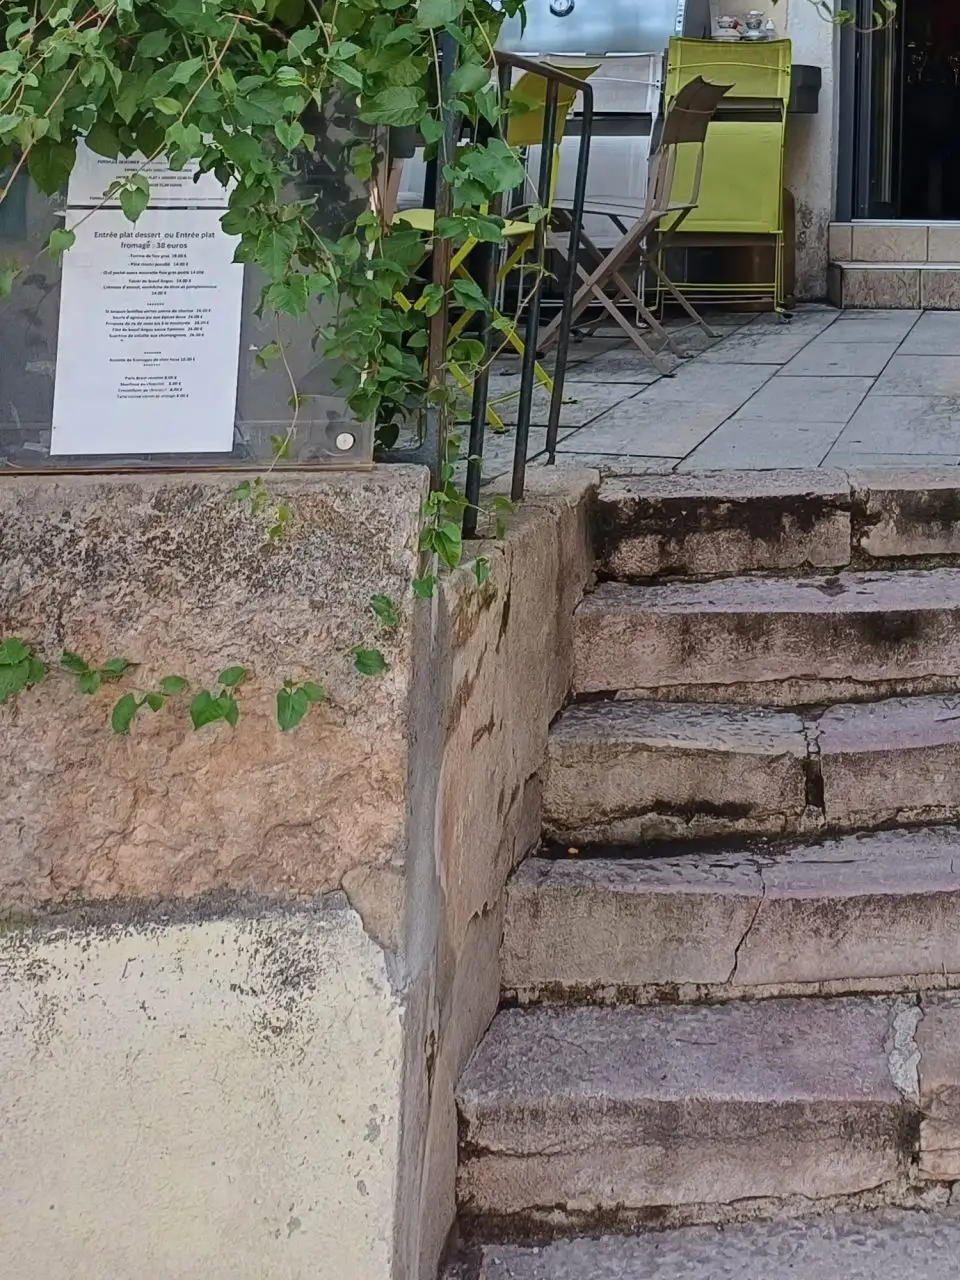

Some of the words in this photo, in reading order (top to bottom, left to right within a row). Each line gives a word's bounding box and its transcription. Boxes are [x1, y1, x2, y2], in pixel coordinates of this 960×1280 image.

[94, 231, 118, 239] Entrée
[119, 231, 134, 240] plat
[135, 231, 161, 239] dessert
[175, 231, 200, 239] Entrée
[201, 231, 215, 240] plat
